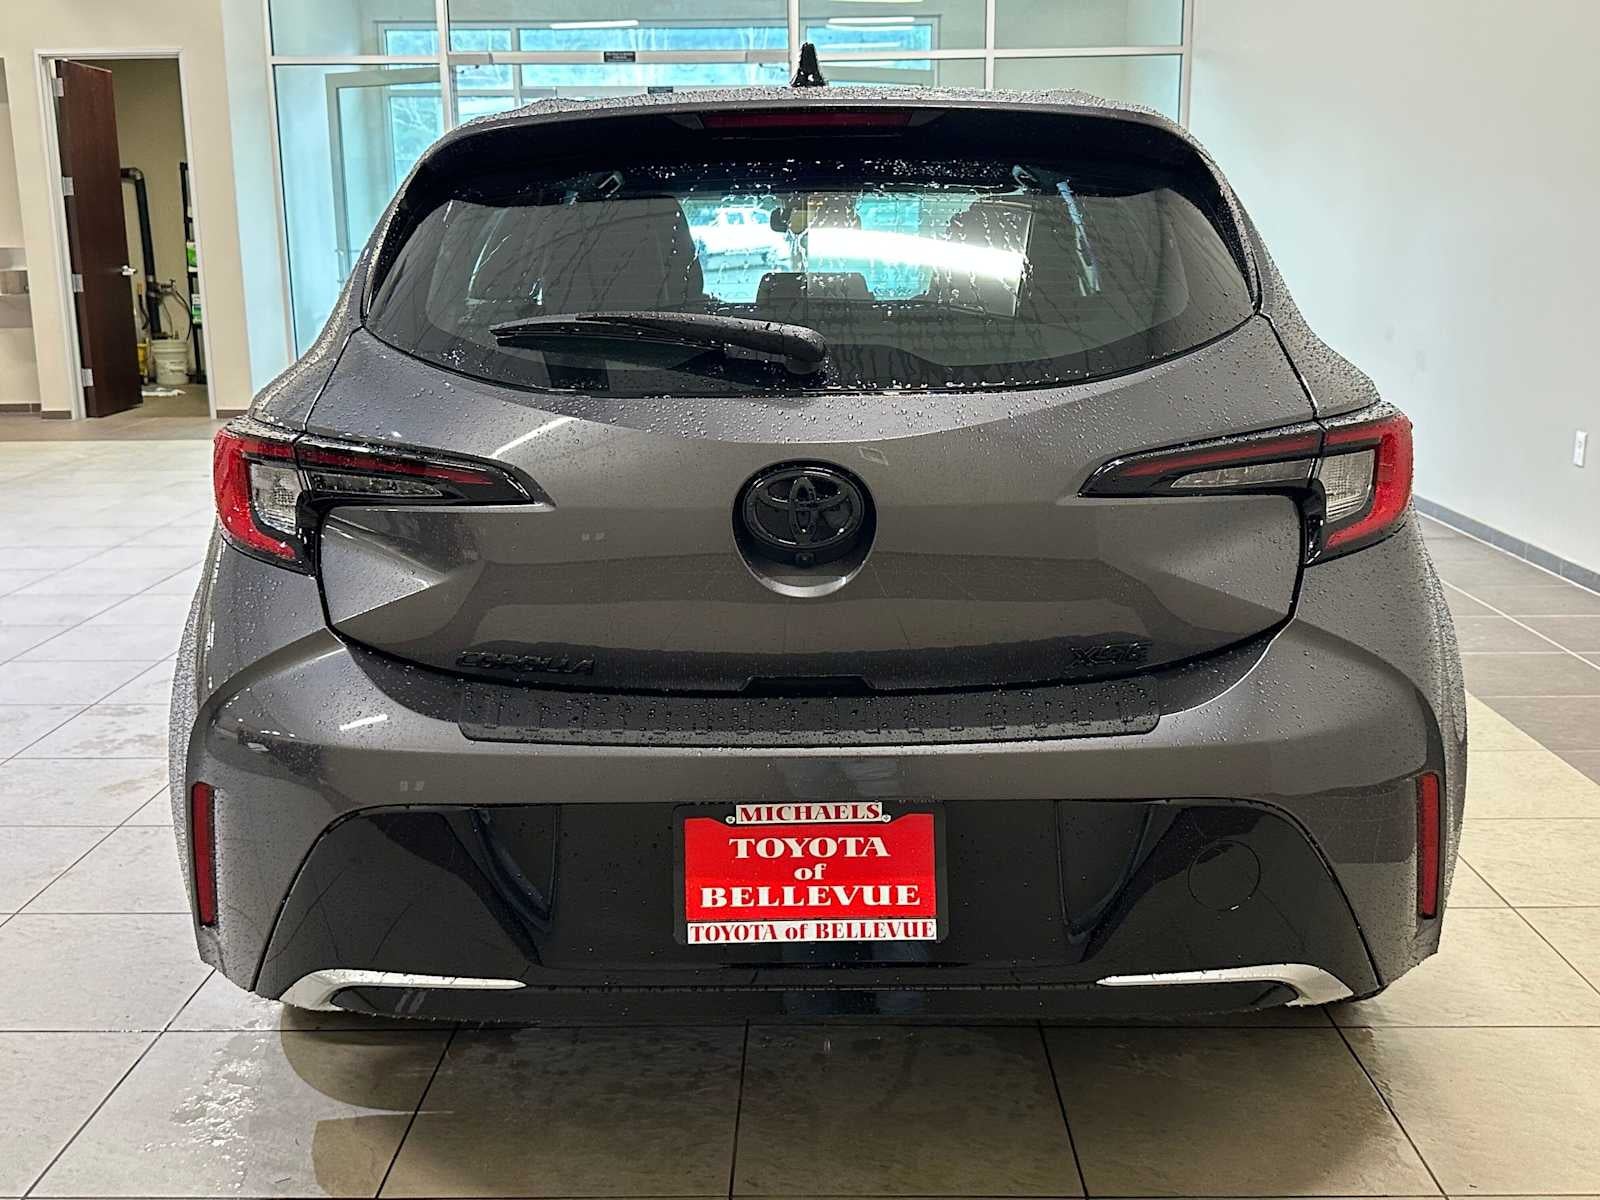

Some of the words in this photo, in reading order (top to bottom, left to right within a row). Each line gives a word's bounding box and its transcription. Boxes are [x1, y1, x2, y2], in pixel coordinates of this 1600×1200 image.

[739, 804, 880, 822] MICHAELS
[729, 836, 890, 859] TOYOTA
[794, 863, 827, 881] of
[700, 885, 920, 908] BELLEVUE
[690, 923, 777, 942] TOYOTA
[785, 923, 808, 940] of
[816, 921, 935, 940] BELLEVUE
